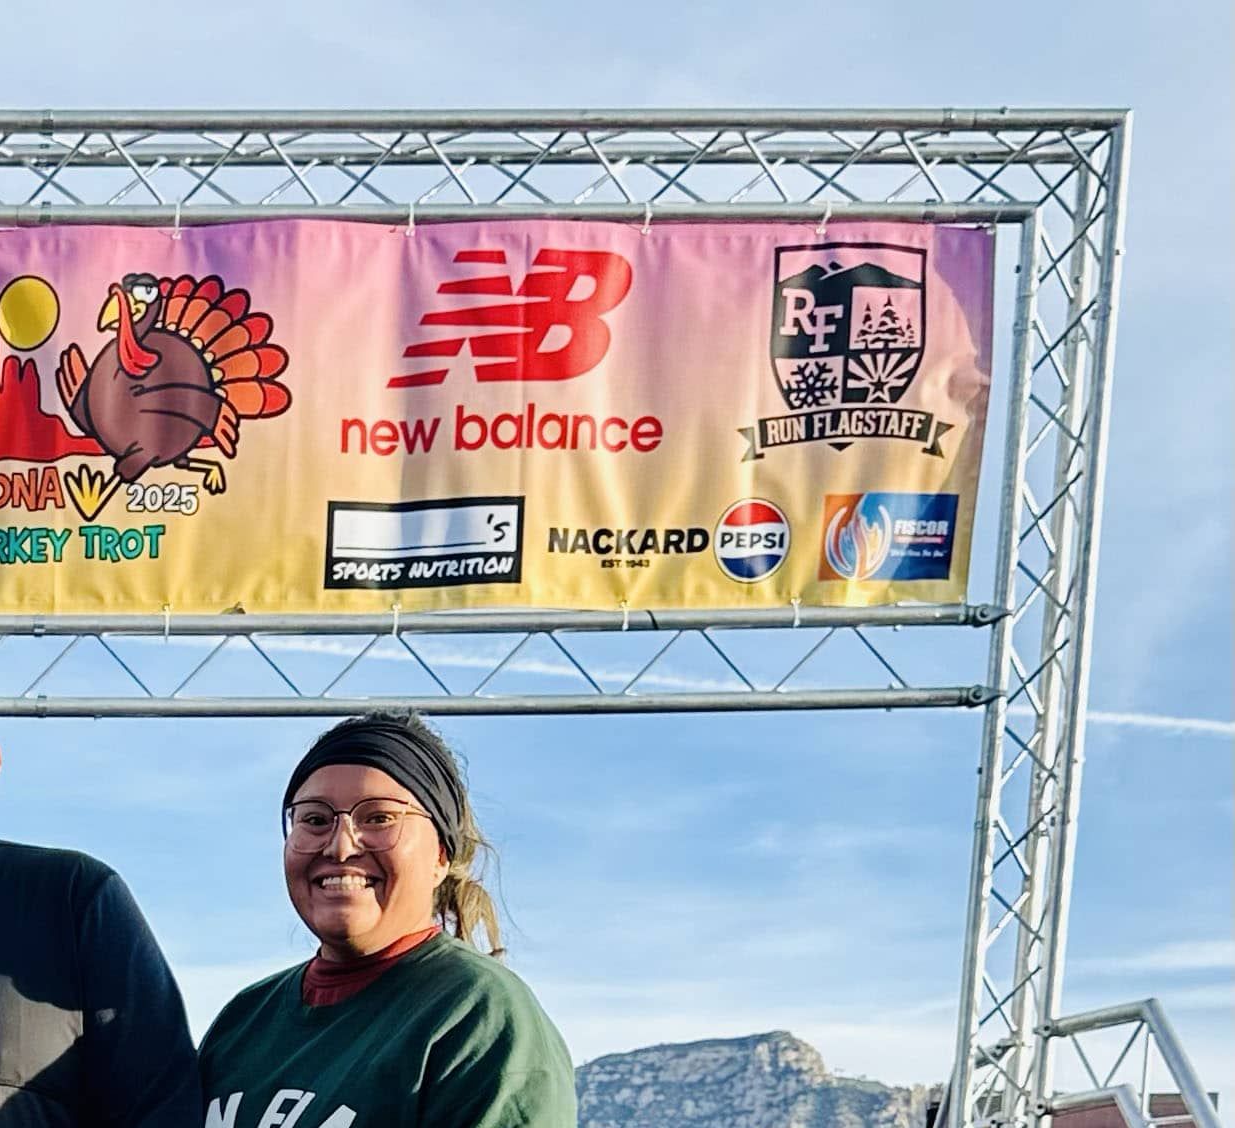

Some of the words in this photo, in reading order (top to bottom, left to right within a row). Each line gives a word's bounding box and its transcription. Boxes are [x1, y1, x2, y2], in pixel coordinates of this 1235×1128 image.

[778, 287, 843, 353] RF
[340, 417, 441, 456] new
[454, 403, 663, 453] balance
[766, 415, 807, 445] RUN
[812, 410, 926, 438] FLAGSTAFF
[126, 483, 199, 516] 2025
[79, 524, 165, 561] TROT
[548, 527, 709, 555] NACKARD
[720, 532, 784, 549] PEPSI
[332, 560, 405, 581] SPORTS
[408, 556, 514, 579] NUTRITION
